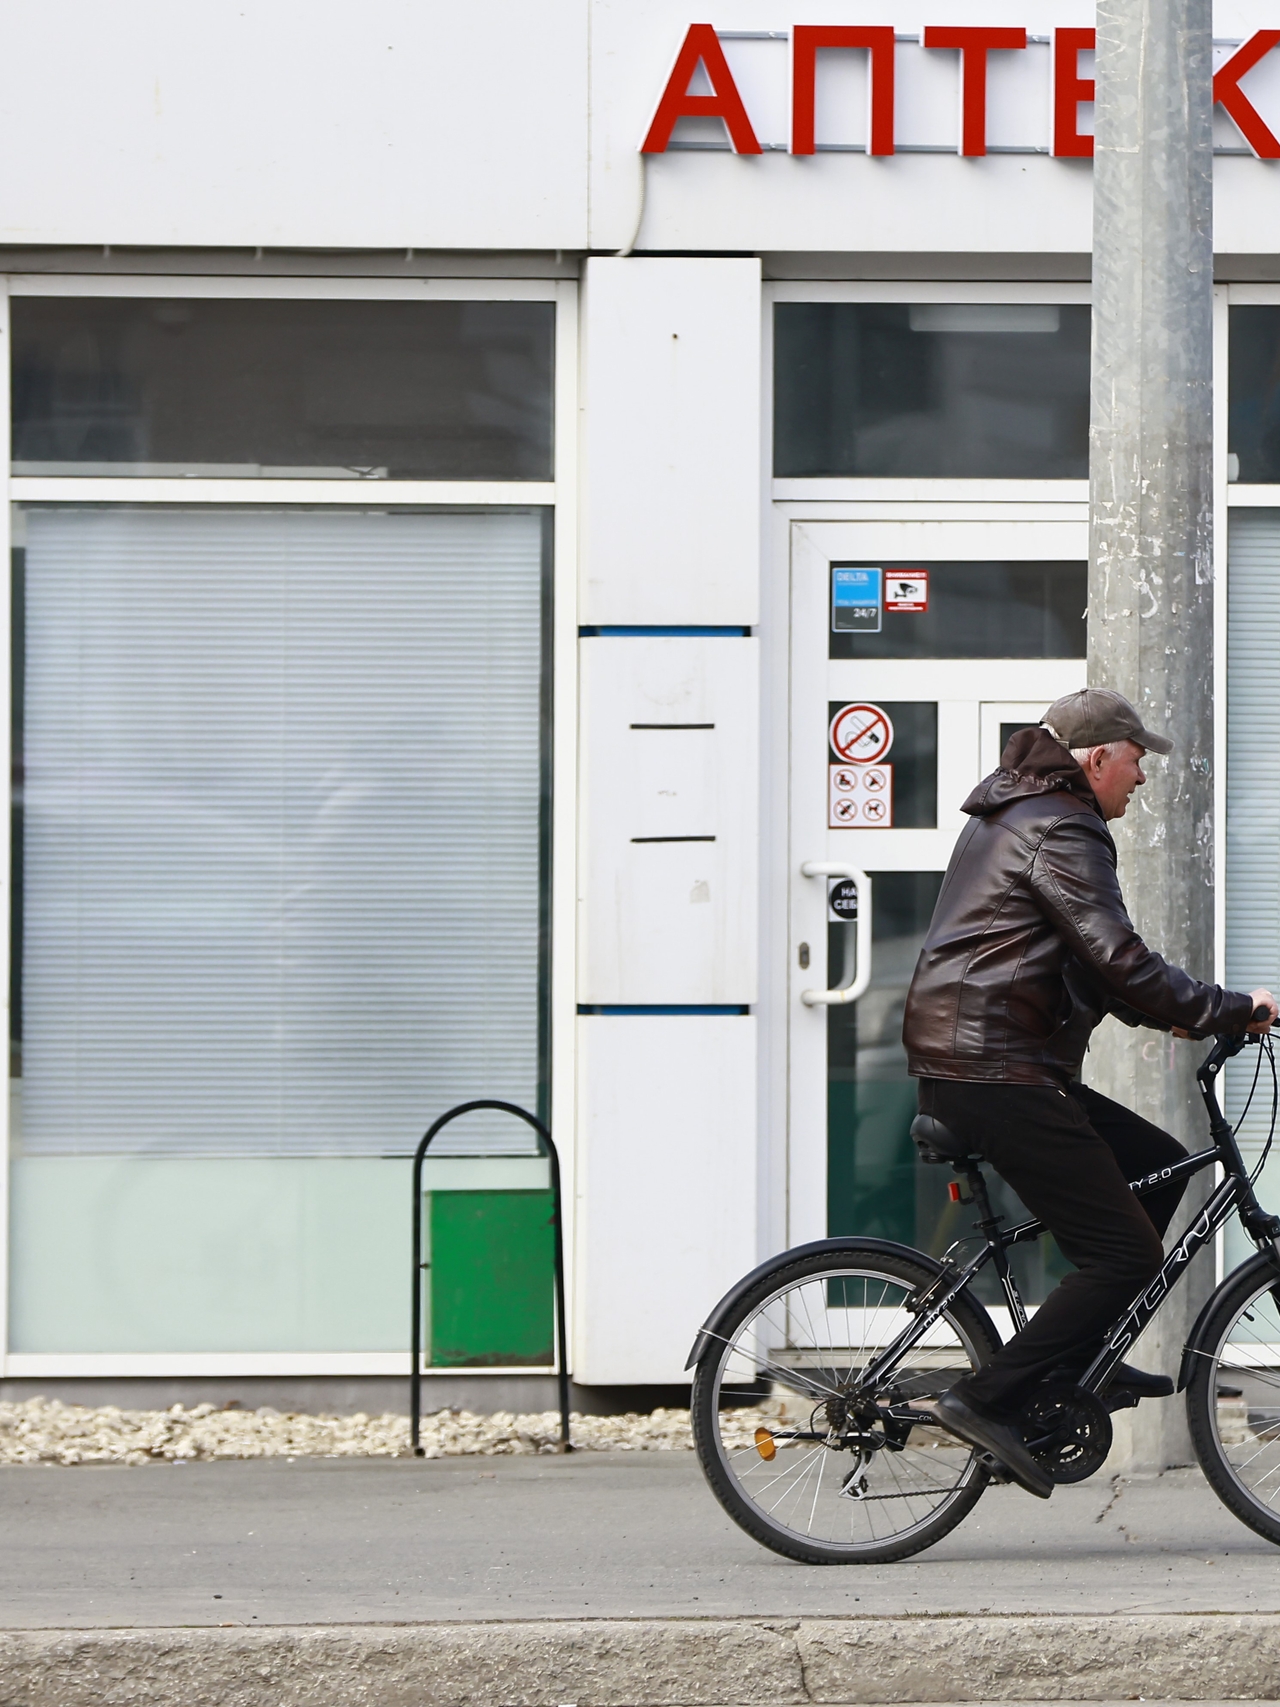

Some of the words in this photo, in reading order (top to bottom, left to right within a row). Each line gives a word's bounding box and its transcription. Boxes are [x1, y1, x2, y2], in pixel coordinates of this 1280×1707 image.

[837, 572, 869, 581] DELTA
[853, 608, 877, 618] 24/7
[841, 887, 857, 897] НА
[833, 899, 858, 910] СЕБ
[1128, 1178, 1144, 1190] TY
[1148, 1168, 1172, 1184] 2.0
[1108, 1210, 1210, 1362] STERN
